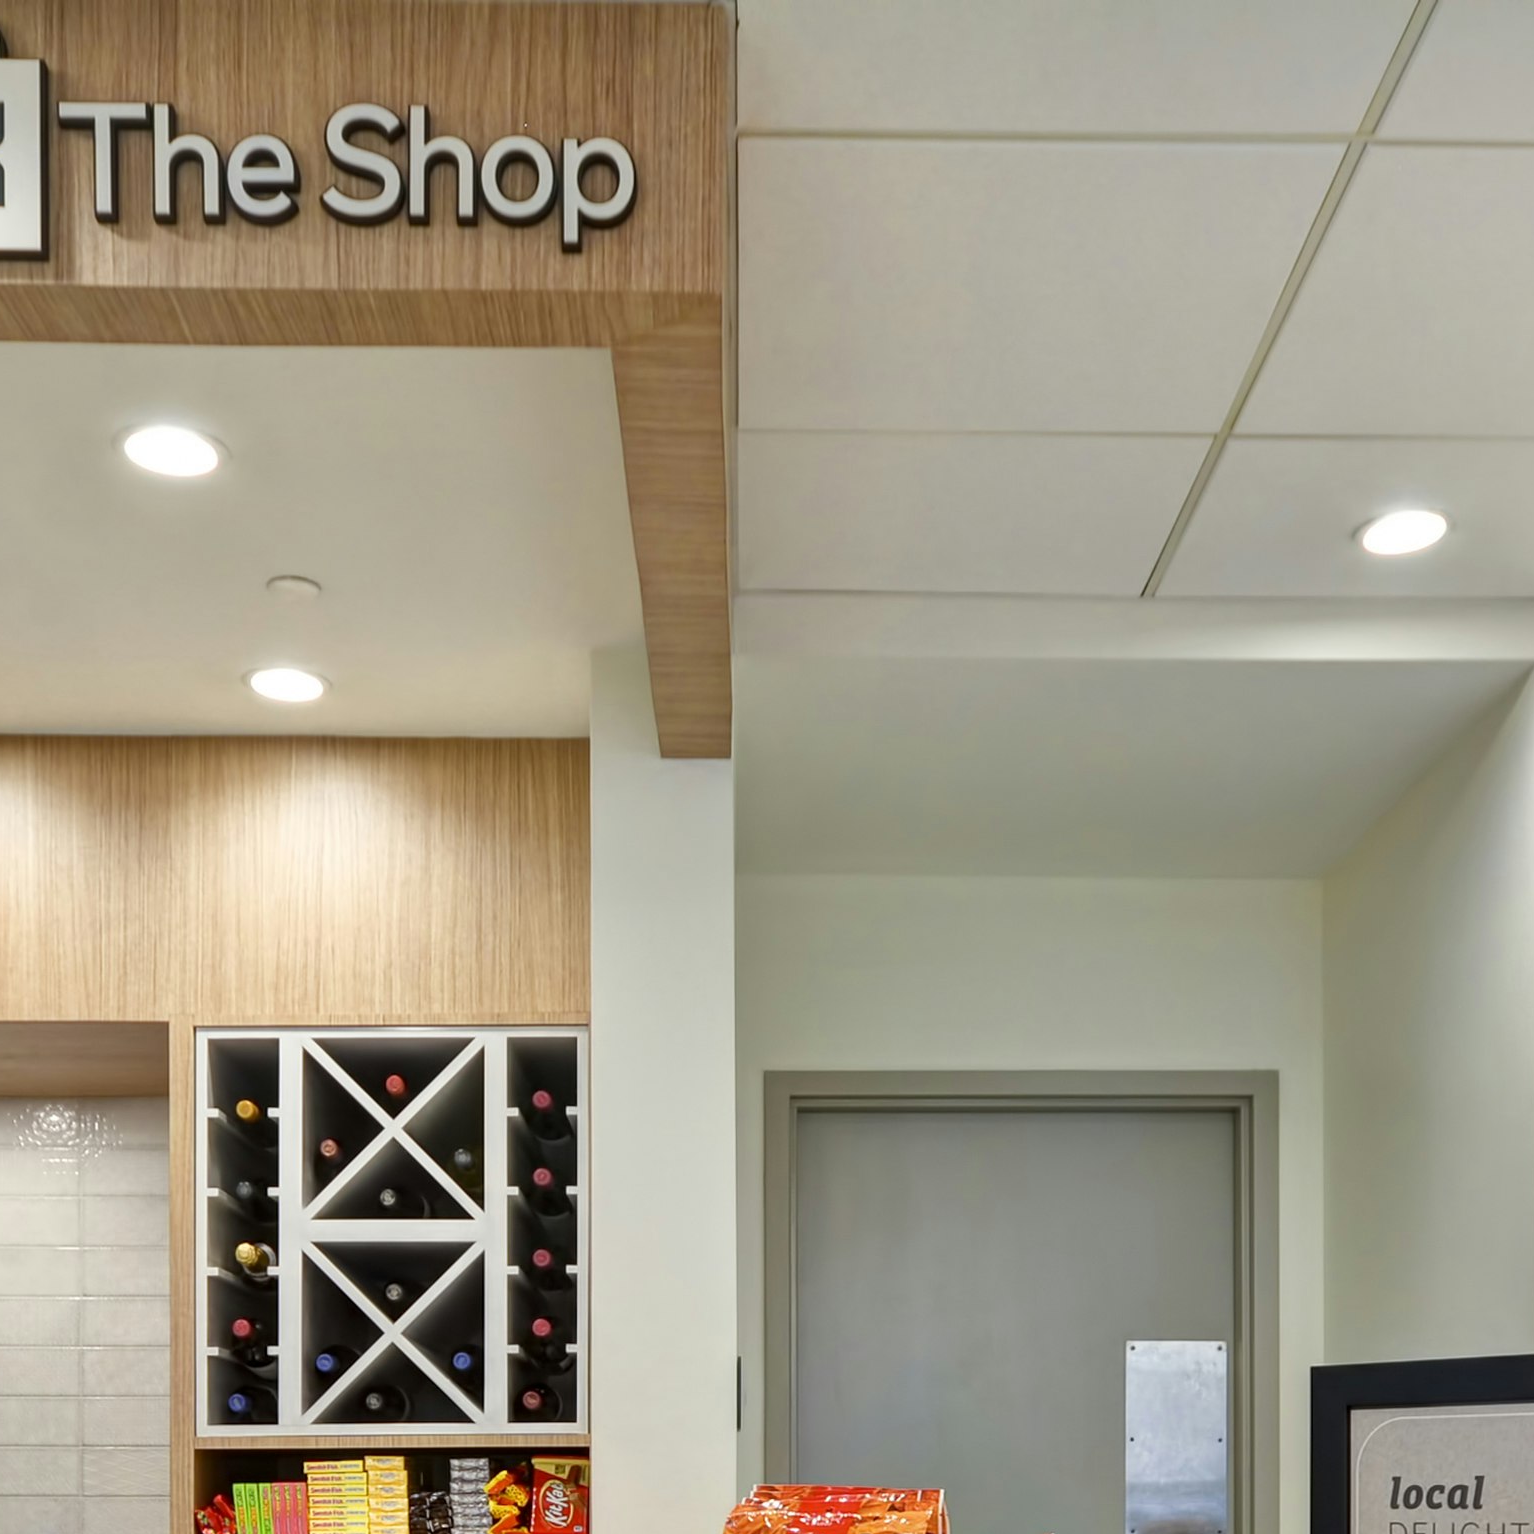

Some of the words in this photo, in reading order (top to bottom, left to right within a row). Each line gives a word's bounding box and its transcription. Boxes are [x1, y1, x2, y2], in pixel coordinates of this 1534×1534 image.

[57, 102, 300, 226] The
[322, 102, 637, 252] Shop
[1389, 1475, 1485, 1511] local
